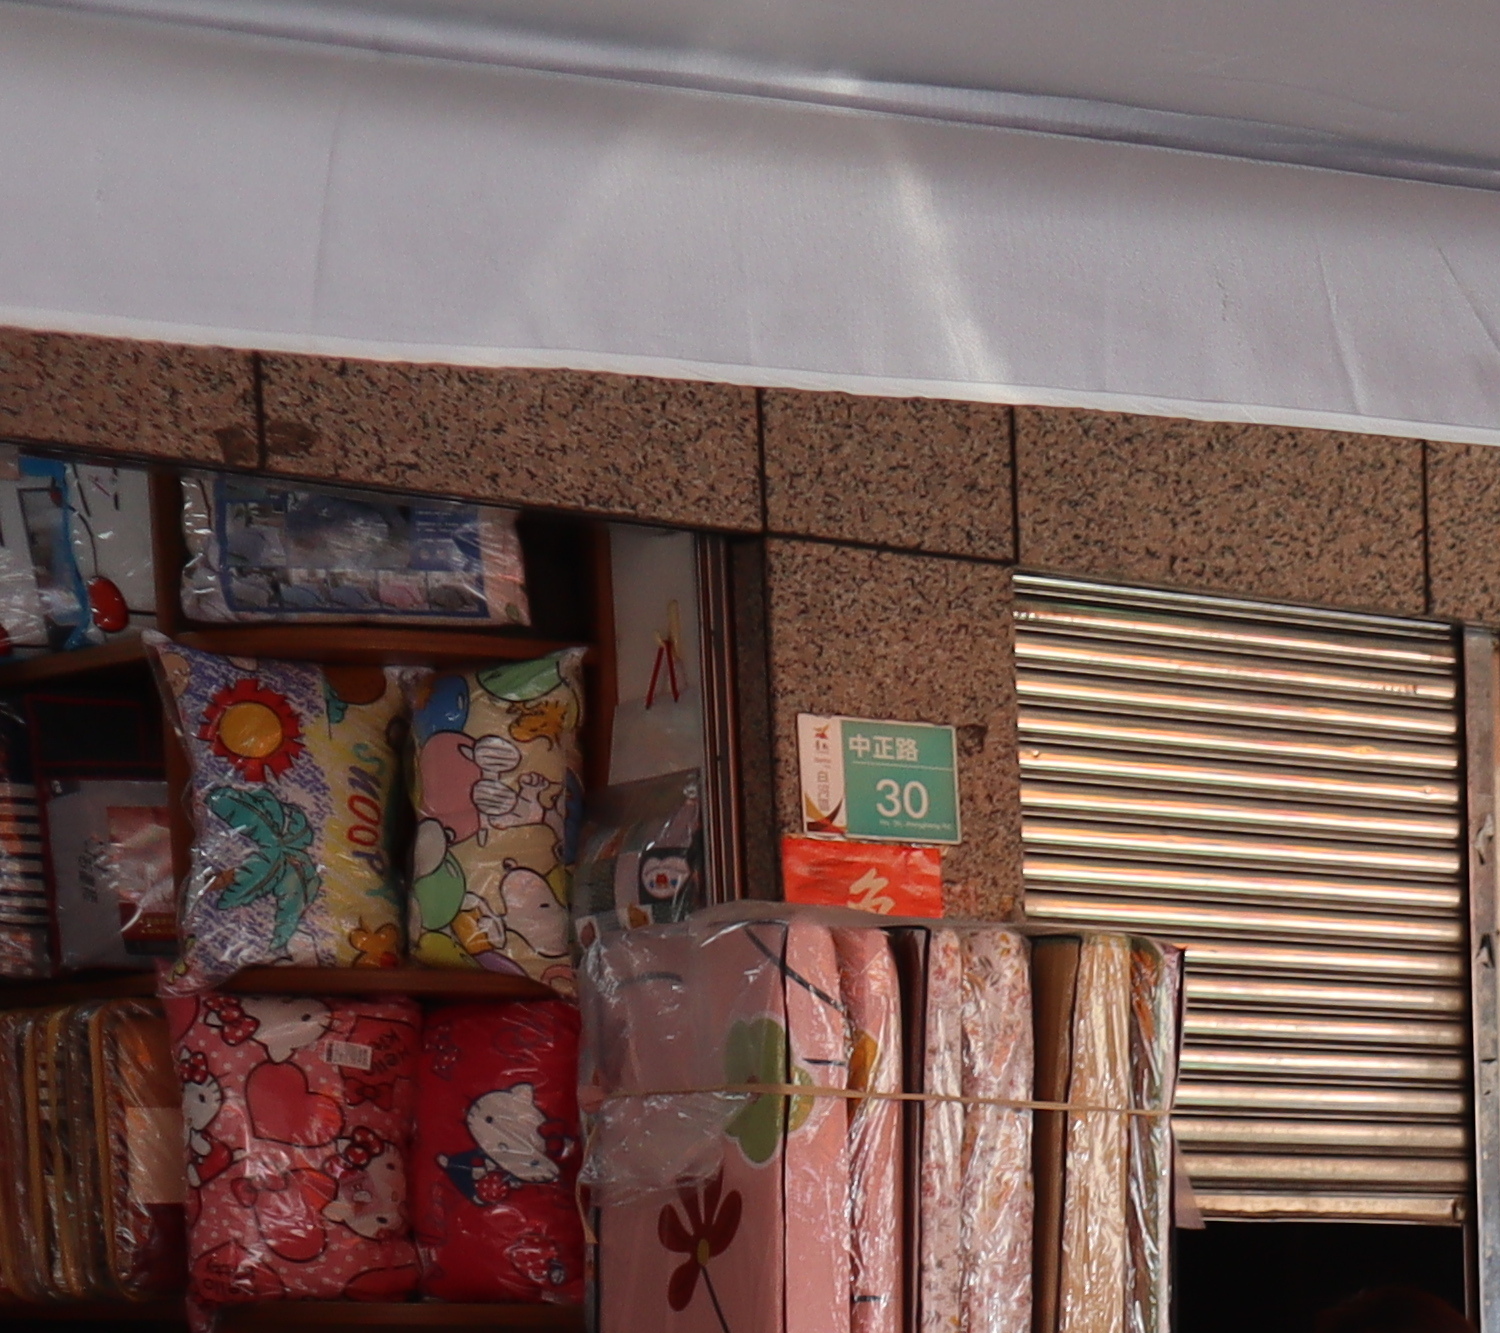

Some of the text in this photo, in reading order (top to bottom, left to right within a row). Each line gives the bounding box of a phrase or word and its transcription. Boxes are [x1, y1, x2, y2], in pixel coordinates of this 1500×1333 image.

[849, 733, 919, 763] 中正路
[875, 778, 930, 819] 30
